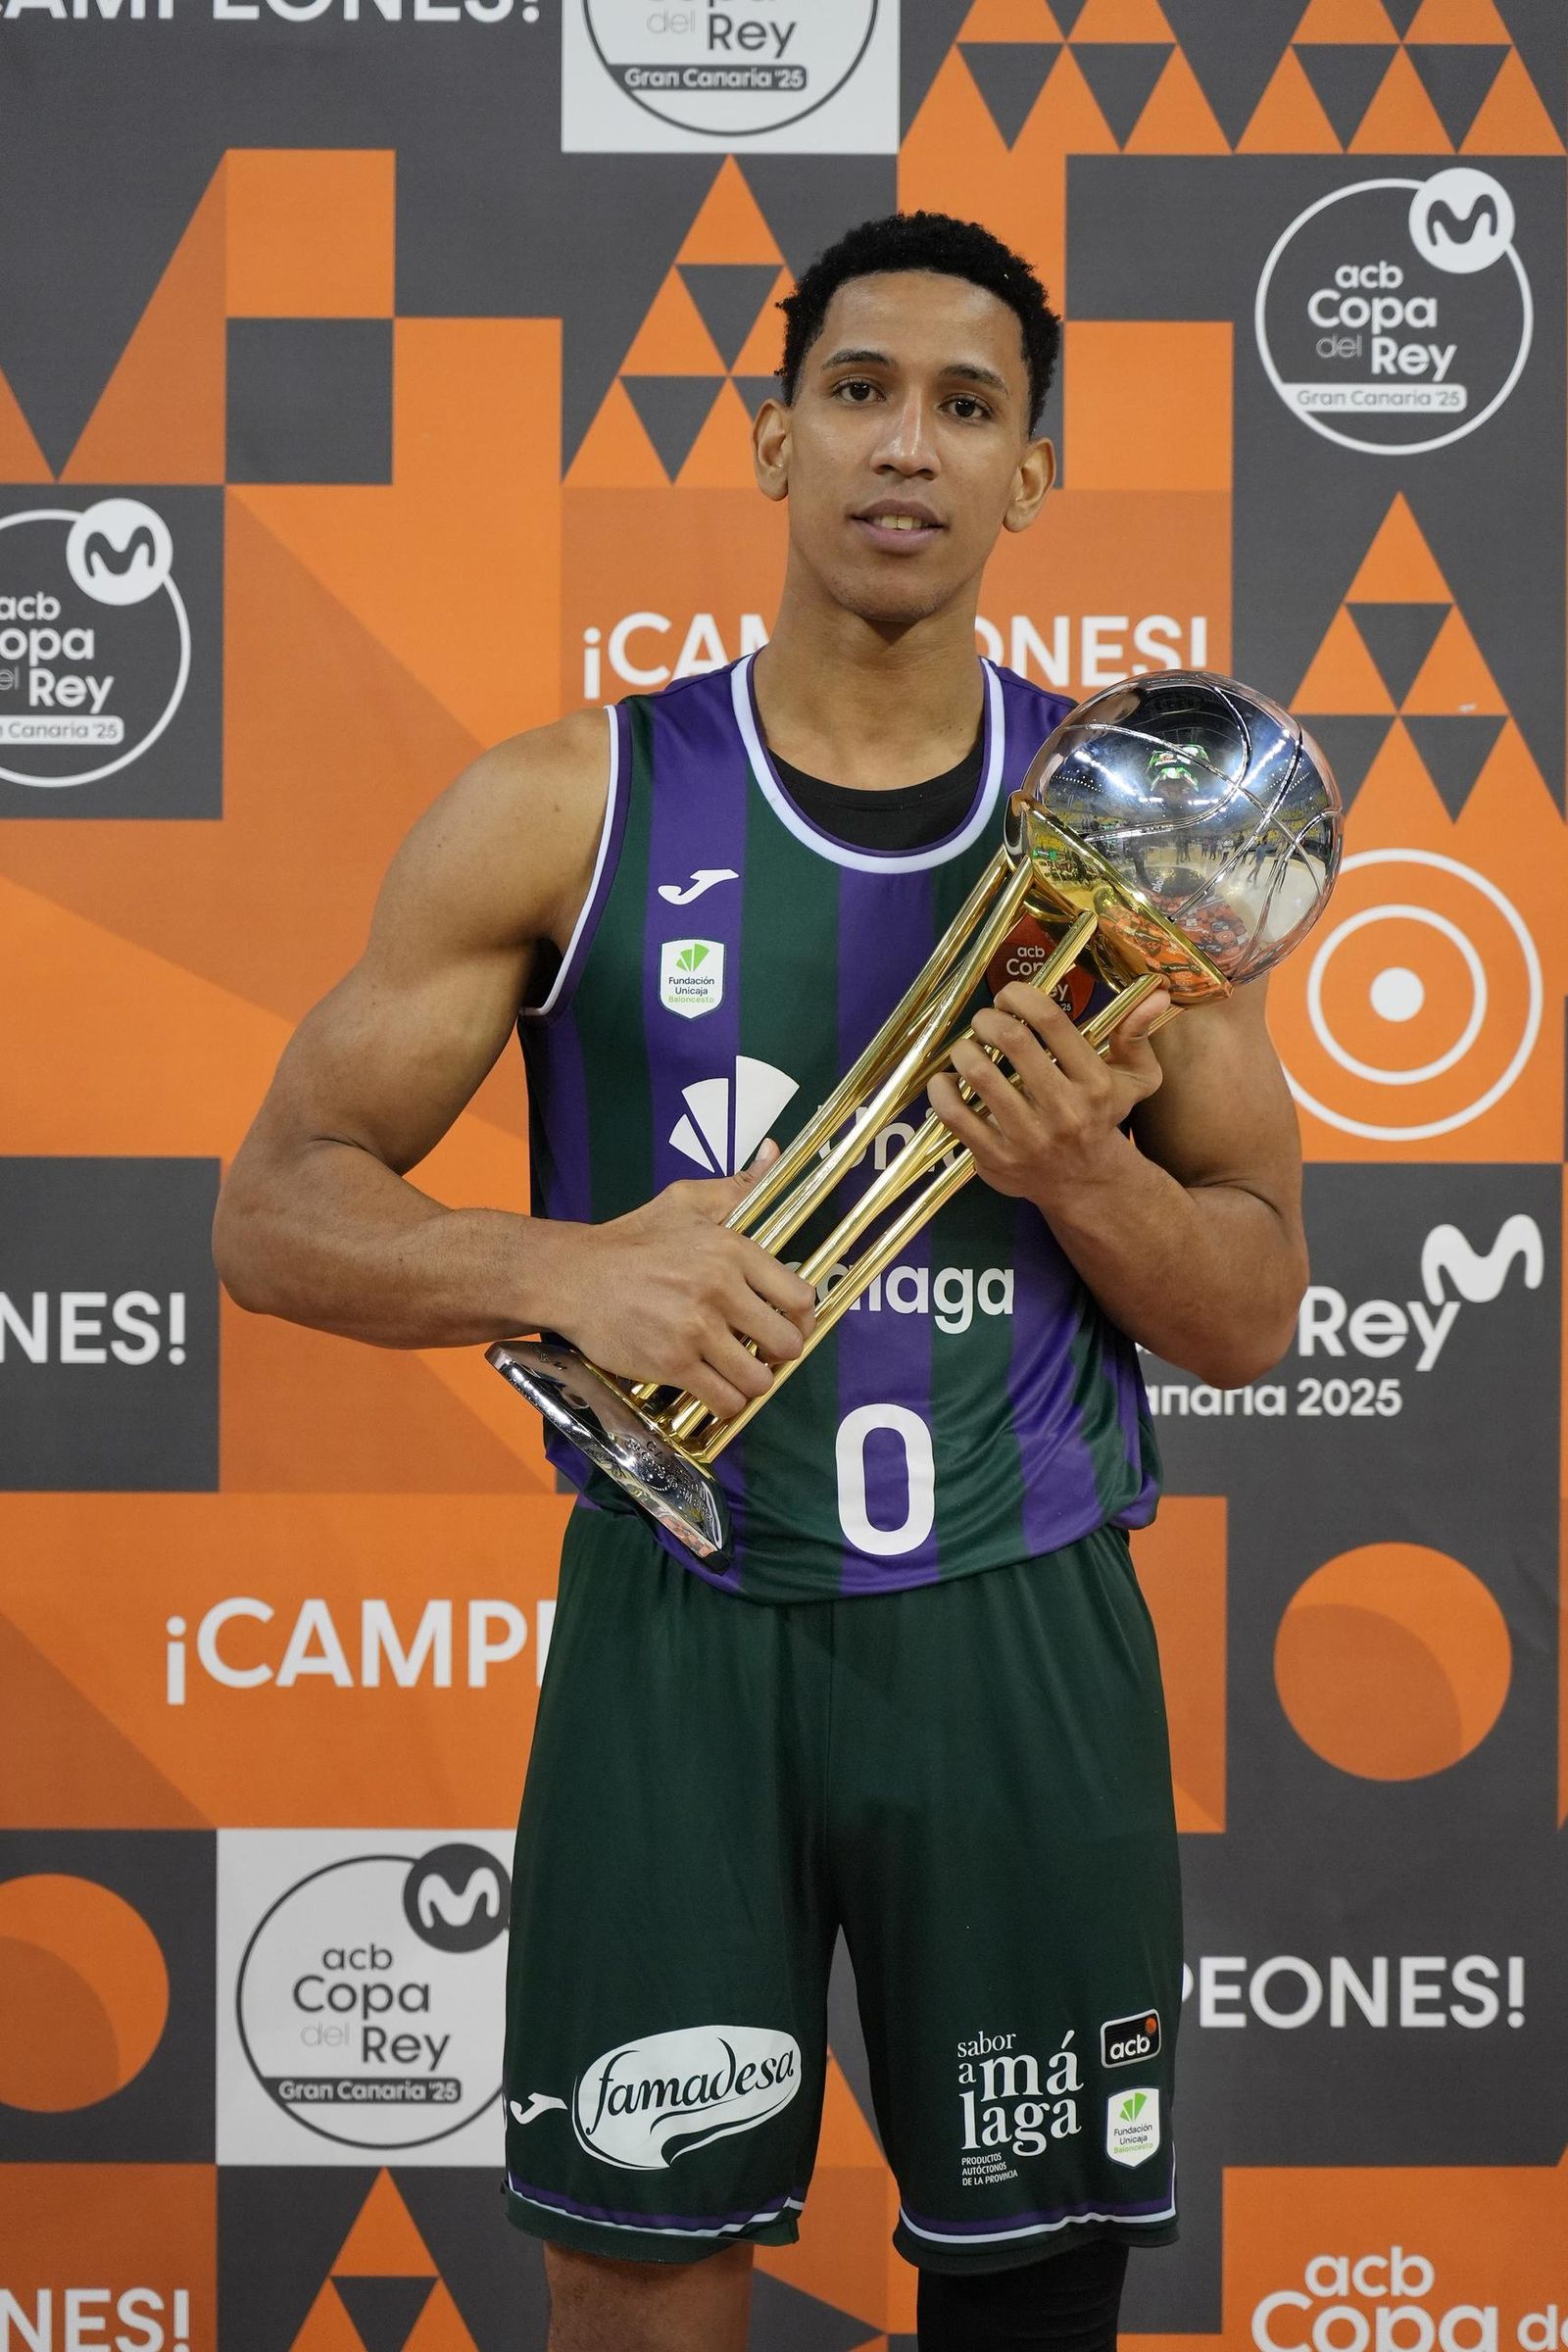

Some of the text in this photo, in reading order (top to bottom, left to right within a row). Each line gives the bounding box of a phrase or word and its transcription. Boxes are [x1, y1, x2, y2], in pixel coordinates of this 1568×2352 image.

[646, 10, 797, 59] del Rey
[624, 68, 679, 87] Gran
[683, 68, 772, 87] Canaria
[1335, 261, 1403, 288] acb
[1307, 289, 1438, 334] Copa
[1316, 333, 1457, 382] del Rey
[1298, 389, 1346, 407] Gran
[1350, 389, 1432, 407] Canaria
[29, 668, 115, 714] Rey
[9, 721, 89, 739] Canaria
[1017, 946, 1046, 957] acb
[668, 976, 714, 985] Fundación
[675, 987, 708, 997] Unicaja
[1298, 1285, 1461, 1371] Rey
[1297, 1378, 1402, 1417] 2025
[835, 1403, 935, 1555] 0
[322, 1943, 393, 1971] acb
[293, 1975, 430, 2020] Copa
[1181, 1954, 1525, 2030] EONES!
[300, 2022, 451, 2072] del Rey
[956, 2031, 1017, 2058] sabor
[1109, 2034, 1151, 2060] acb
[585, 2036, 795, 2135] famadesa
[958, 2062, 977, 2084] a
[278, 2081, 334, 2100] Gran
[337, 2081, 426, 2100] Canaria
[958, 2090, 1082, 2156] laga
[1113, 2124, 1153, 2136] Fundación
[1119, 2134, 1149, 2145] Unicaja
[961, 2152, 1002, 2166] PRODUCTOS
[961, 2161, 1007, 2176] AUTÓCTONOS
[962, 2169, 1019, 2185] DE LA PROVINCIA
[1304, 2245, 1436, 2297] acb
[1517, 2303, 1568, 2352] d
